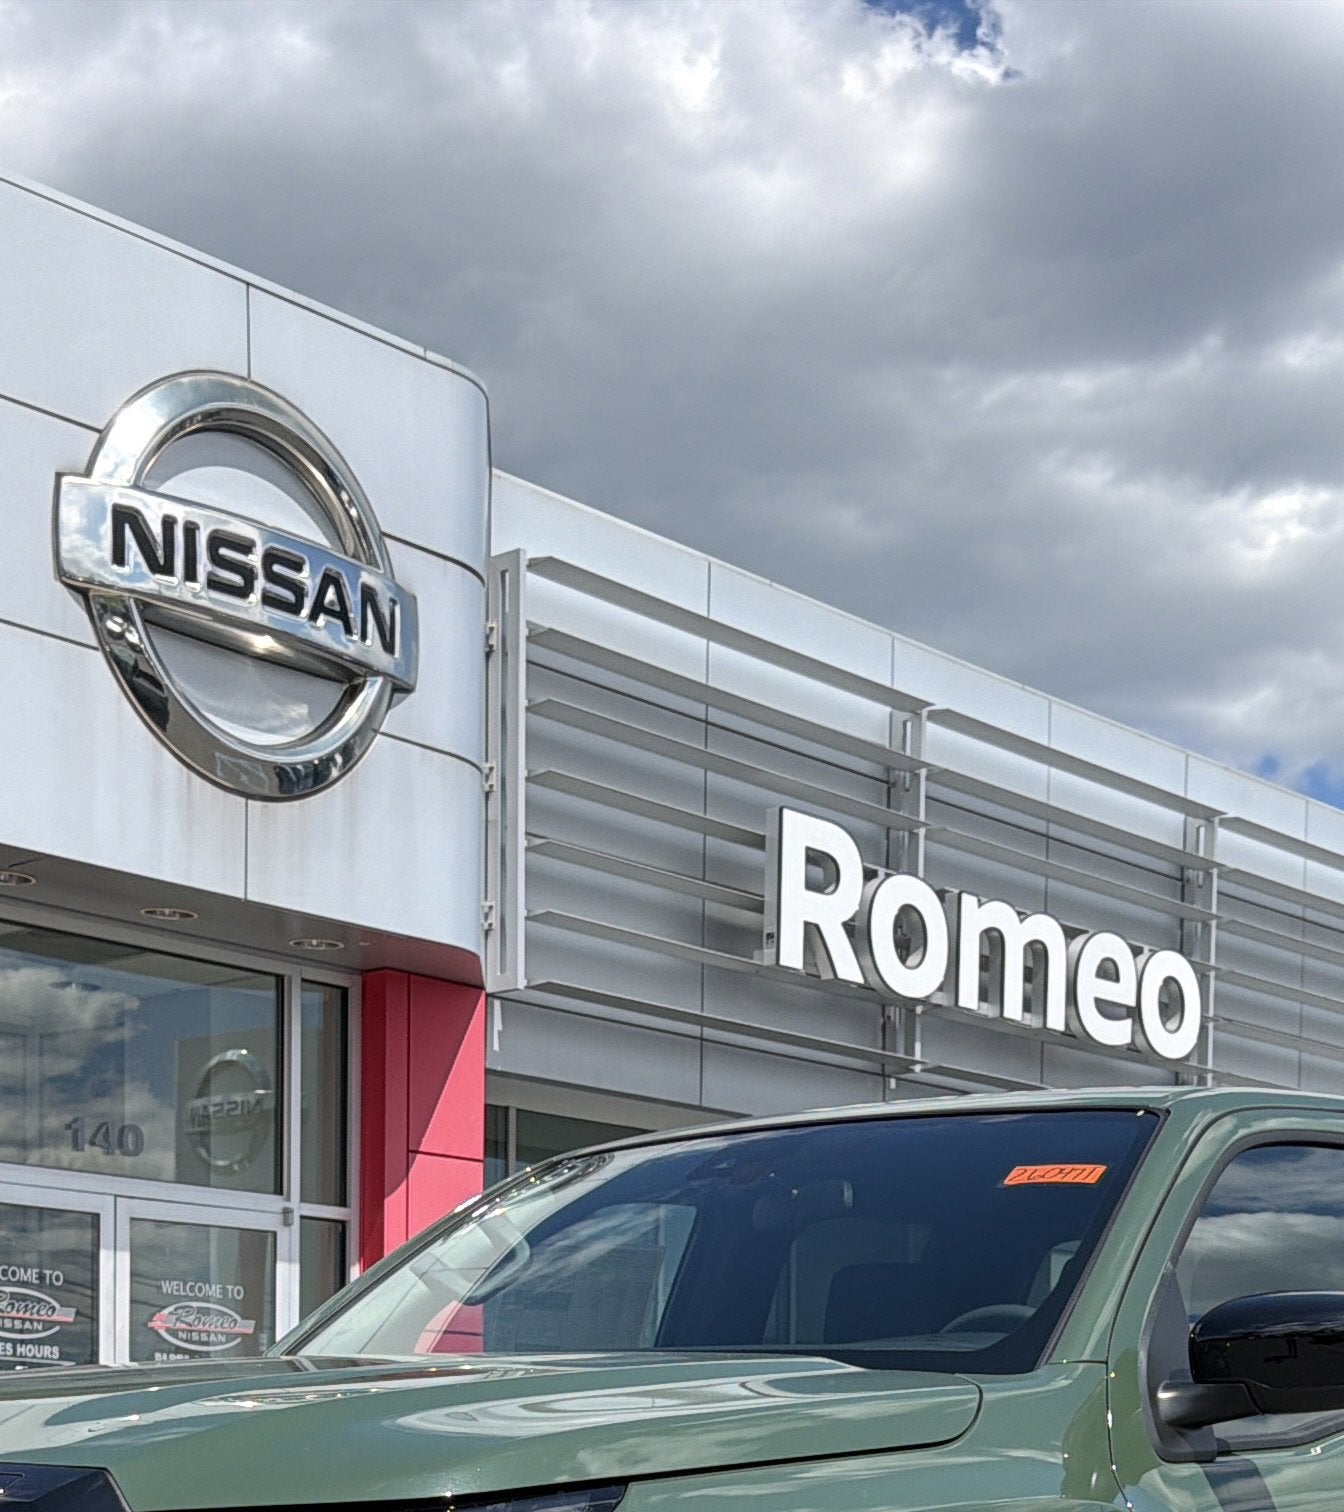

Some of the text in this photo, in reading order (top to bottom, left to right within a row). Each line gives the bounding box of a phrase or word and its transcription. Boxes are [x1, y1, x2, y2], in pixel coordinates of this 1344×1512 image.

[110, 502, 401, 660] NISSAN
[771, 805, 1202, 1061] Romeo
[64, 1116, 145, 1158] 140
[43, 1269, 64, 1286] TO
[161, 1280, 244, 1300] WELCOME TO
[169, 1305, 239, 1330] Romeo
[178, 1331, 227, 1343] NISSAN
[16, 1343, 60, 1359] HOURS
